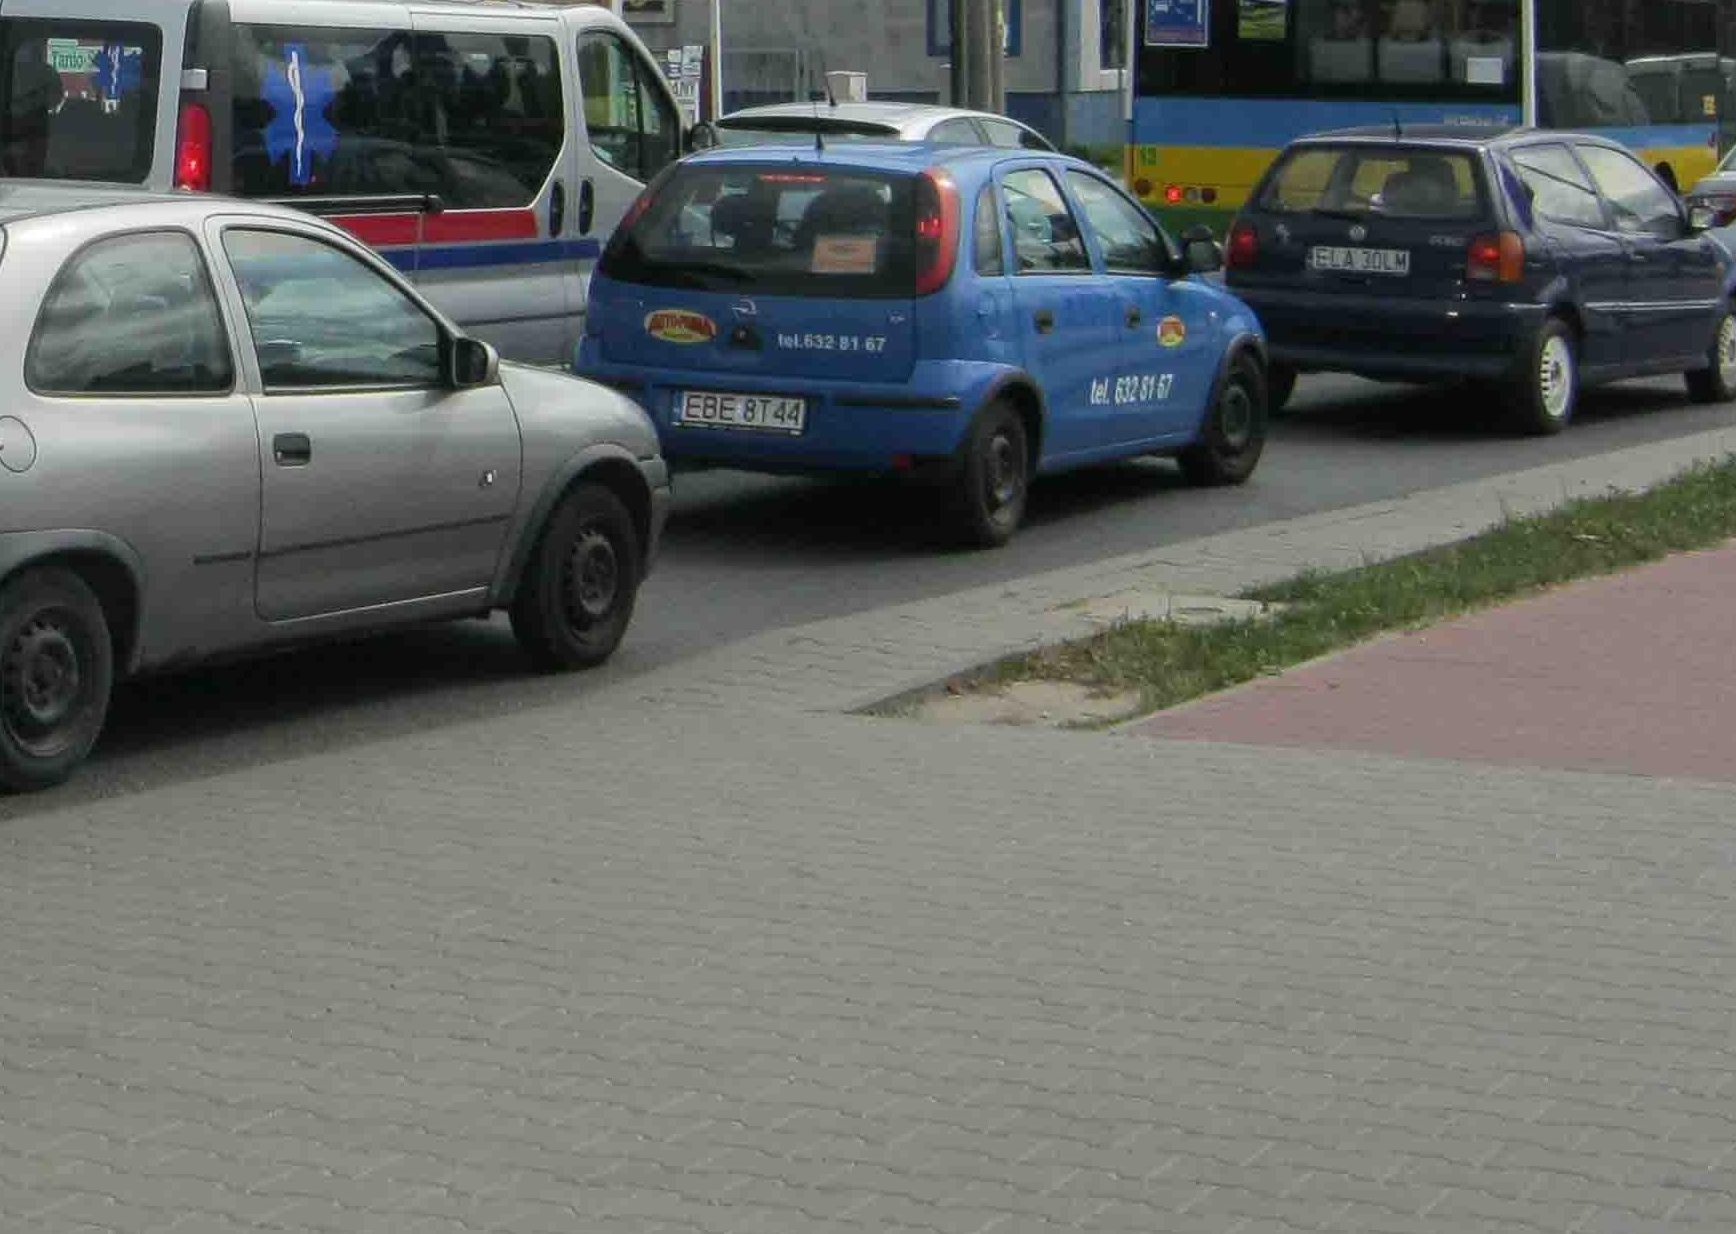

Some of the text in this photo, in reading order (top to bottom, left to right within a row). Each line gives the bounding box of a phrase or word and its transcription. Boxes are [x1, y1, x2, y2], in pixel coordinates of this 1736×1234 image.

[839, 336, 859, 351] 81
[865, 337, 886, 352] 67
[685, 394, 801, 426] EBE 8T44
